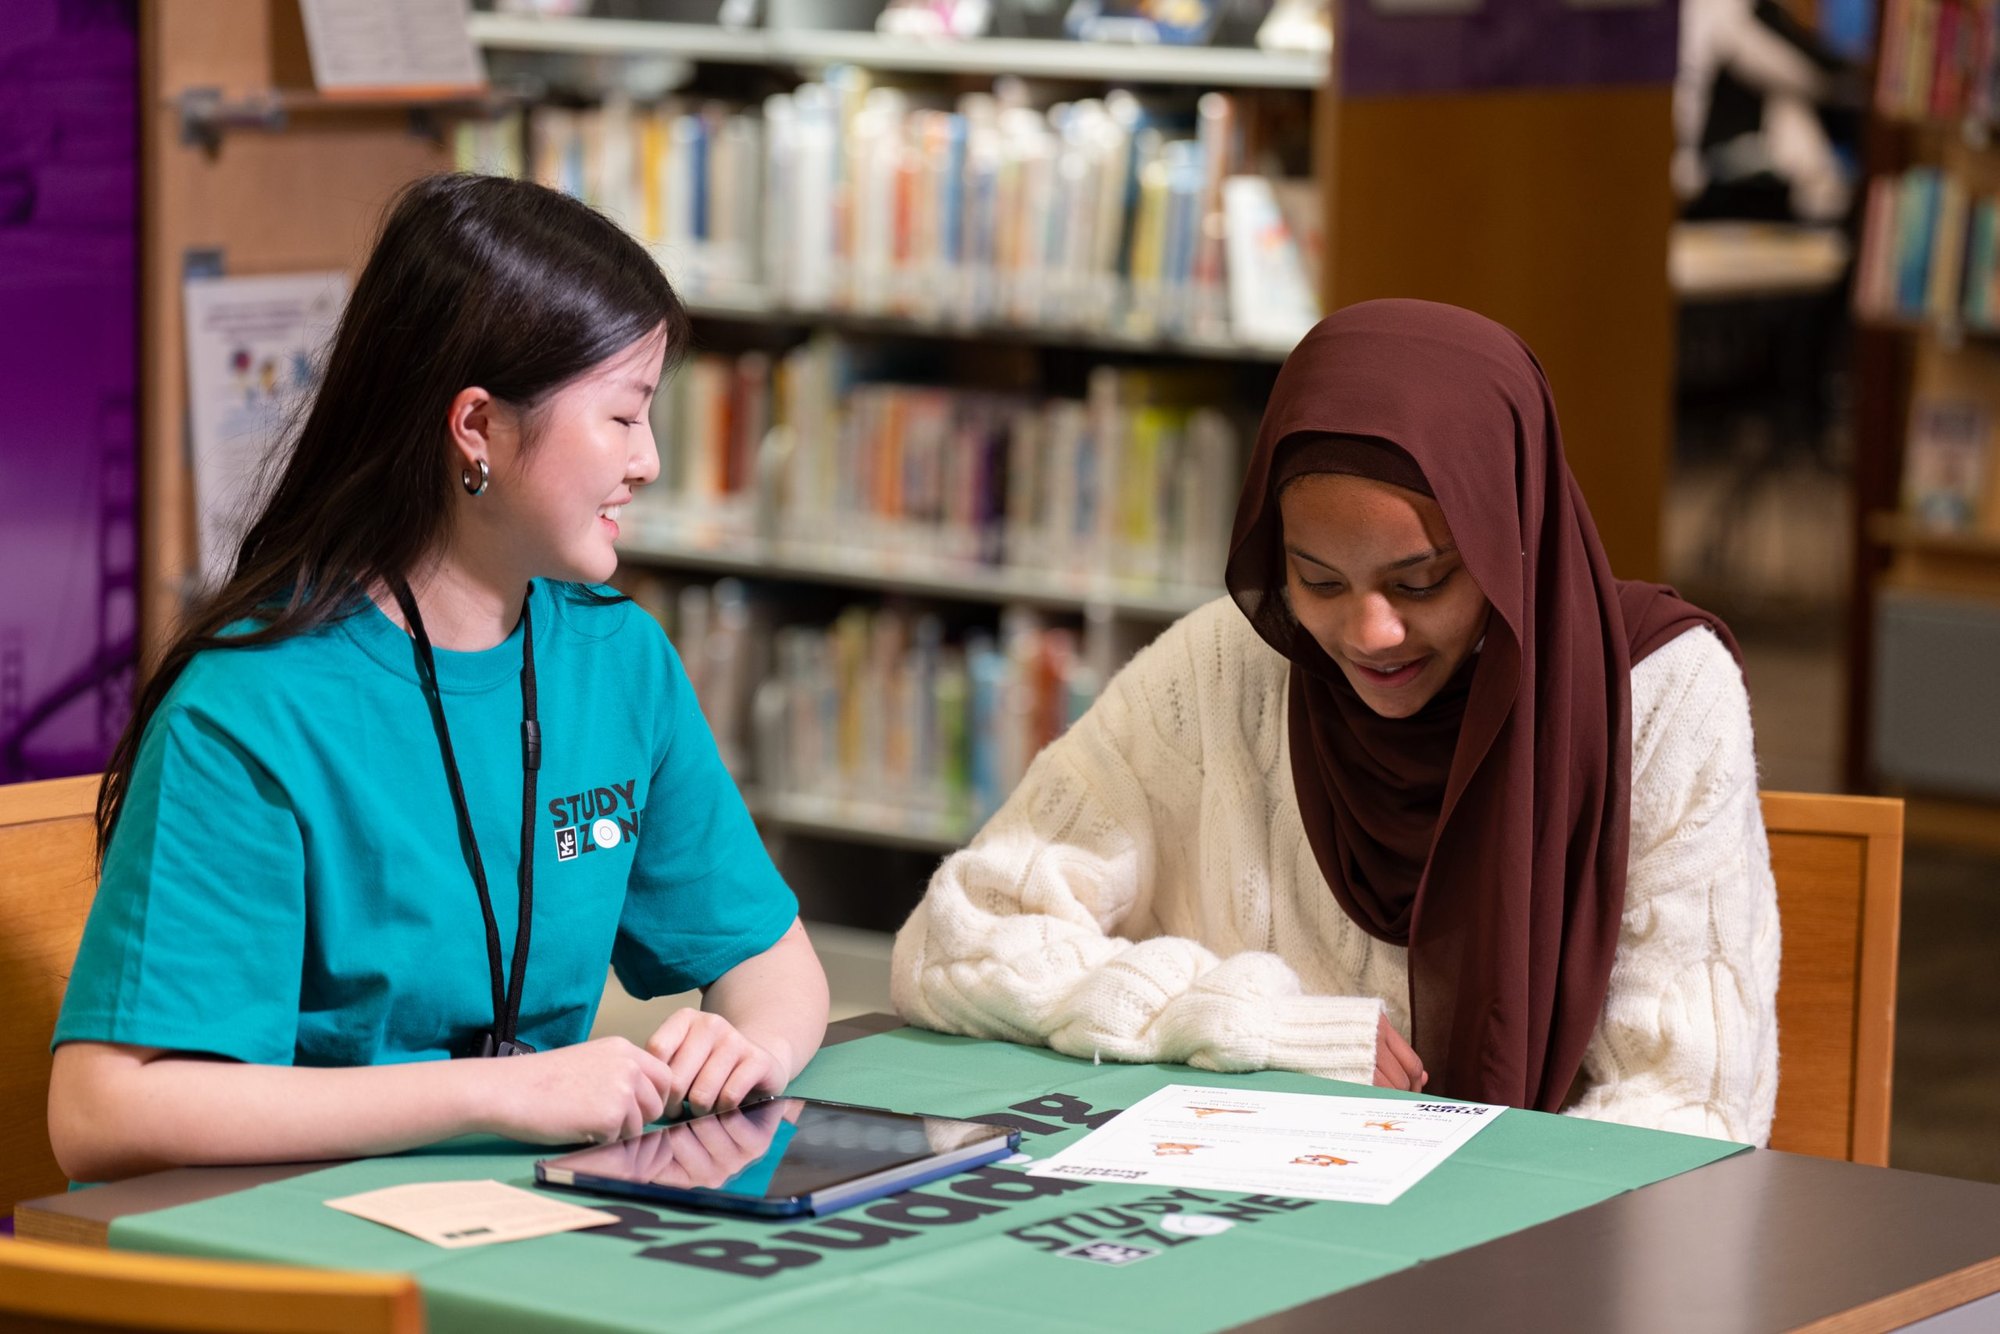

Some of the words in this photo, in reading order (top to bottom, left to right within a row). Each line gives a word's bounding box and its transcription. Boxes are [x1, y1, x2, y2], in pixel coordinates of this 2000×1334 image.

[548, 779, 636, 829] STUDY
[579, 811, 639, 854] ZON
[632, 1166, 1096, 1278] Budd
[1003, 1189, 1219, 1252] STUDY
[1117, 1194, 1317, 1248] ZONE
